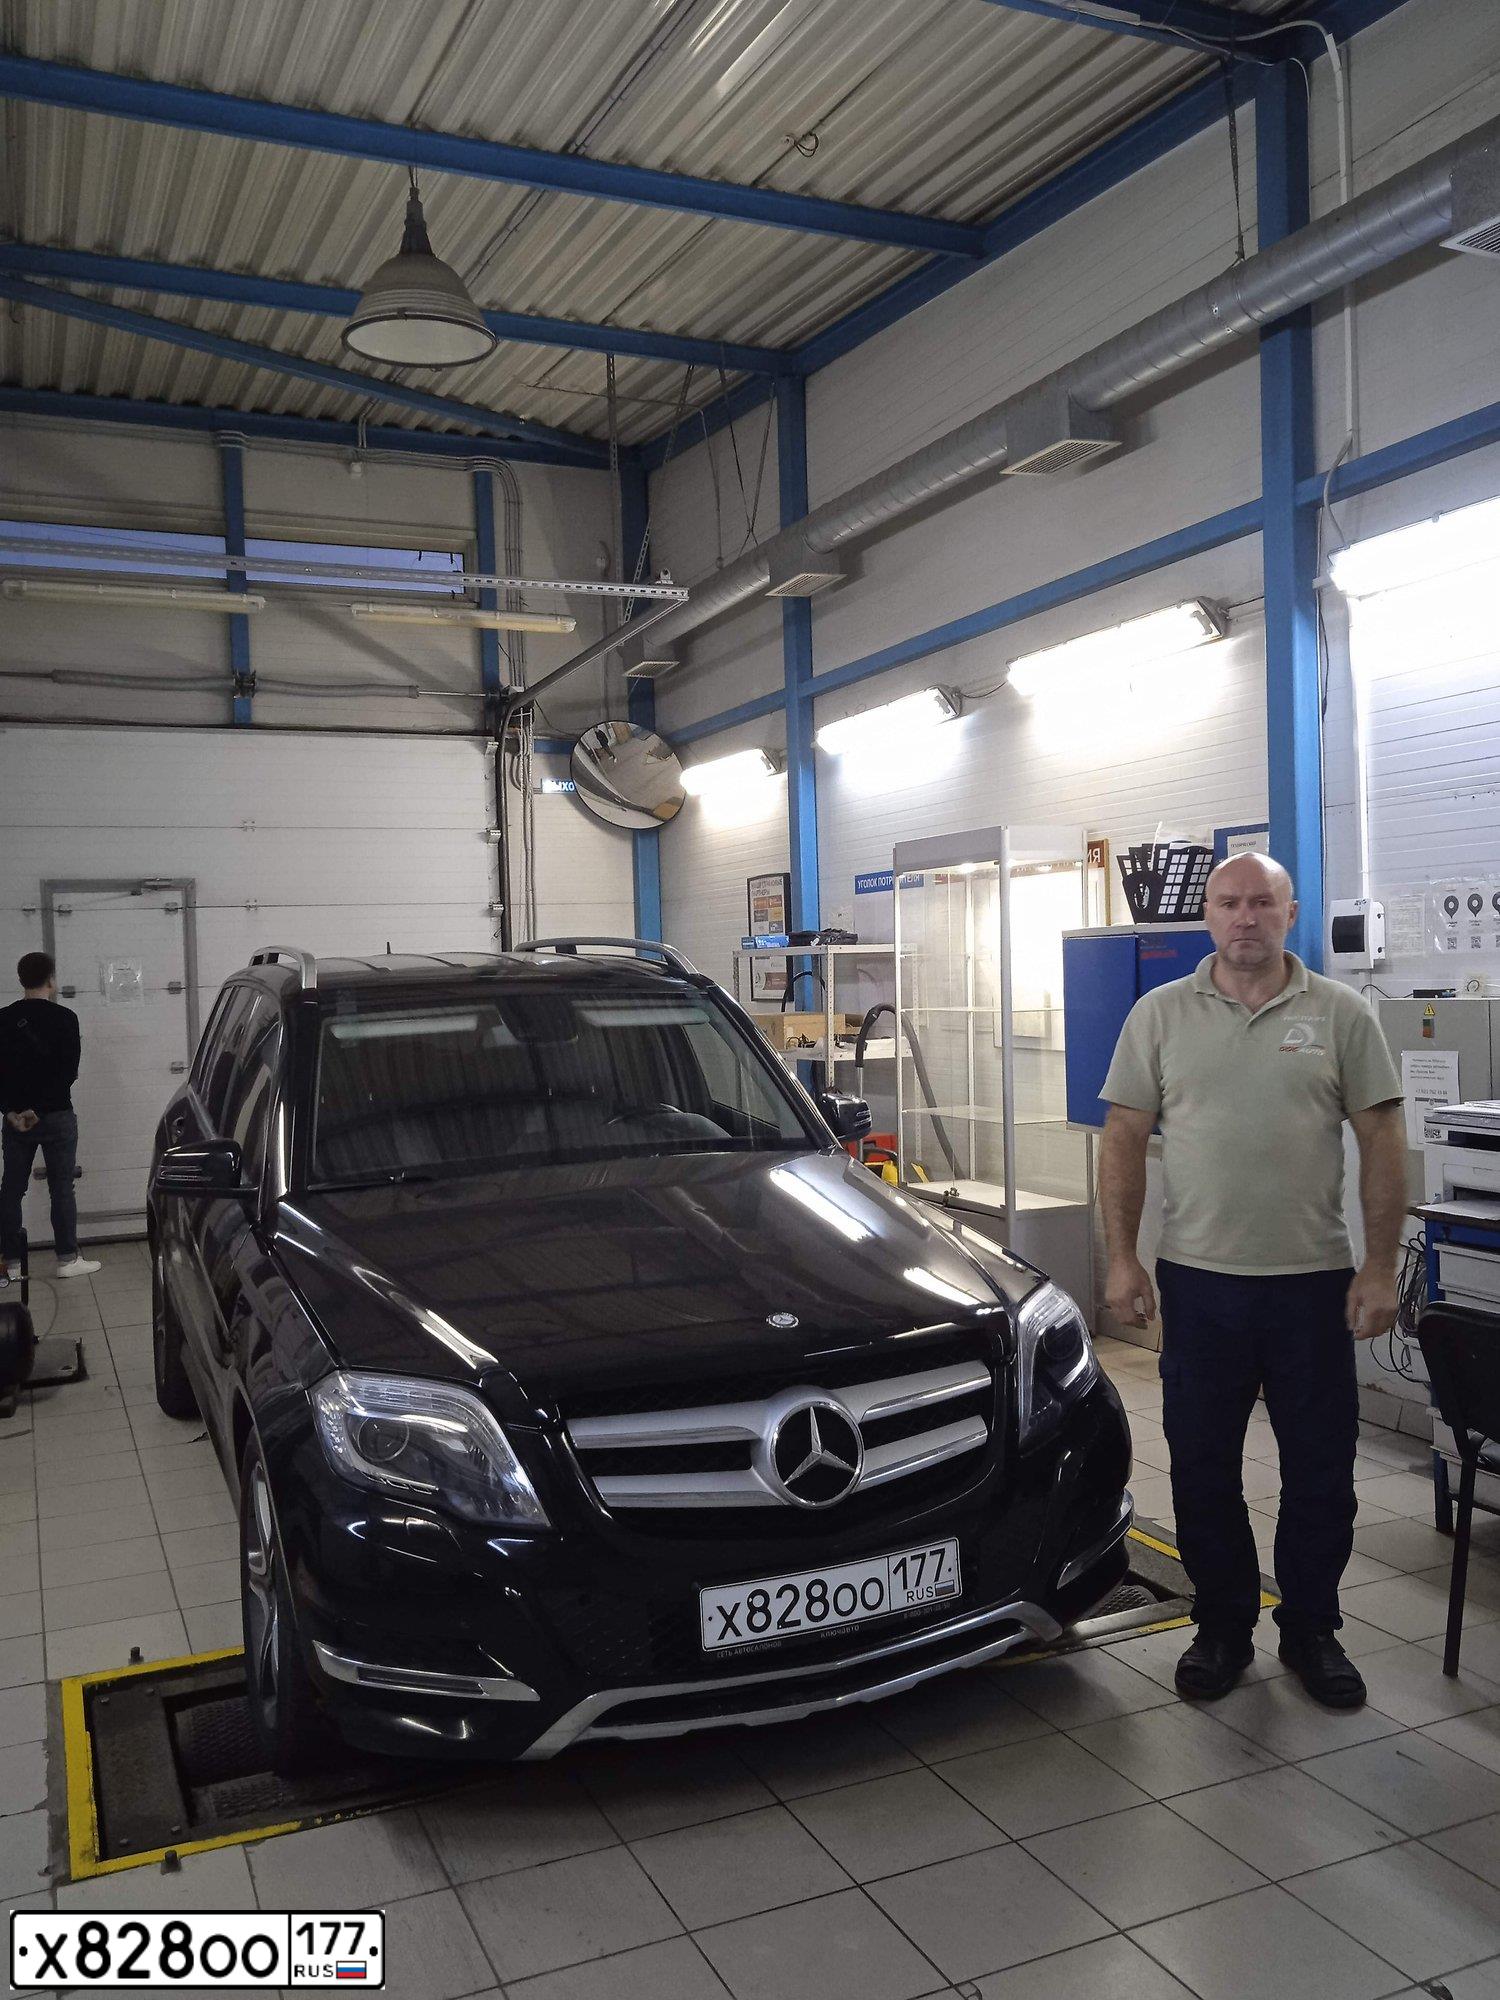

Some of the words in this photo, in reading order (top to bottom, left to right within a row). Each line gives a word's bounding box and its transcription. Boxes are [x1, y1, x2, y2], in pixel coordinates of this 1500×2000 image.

[543, 781, 575, 791] ЫХО
[857, 877, 878, 889] УГОЛОК
[892, 1548, 946, 1590] 177
[906, 1586, 934, 1603] RUS
